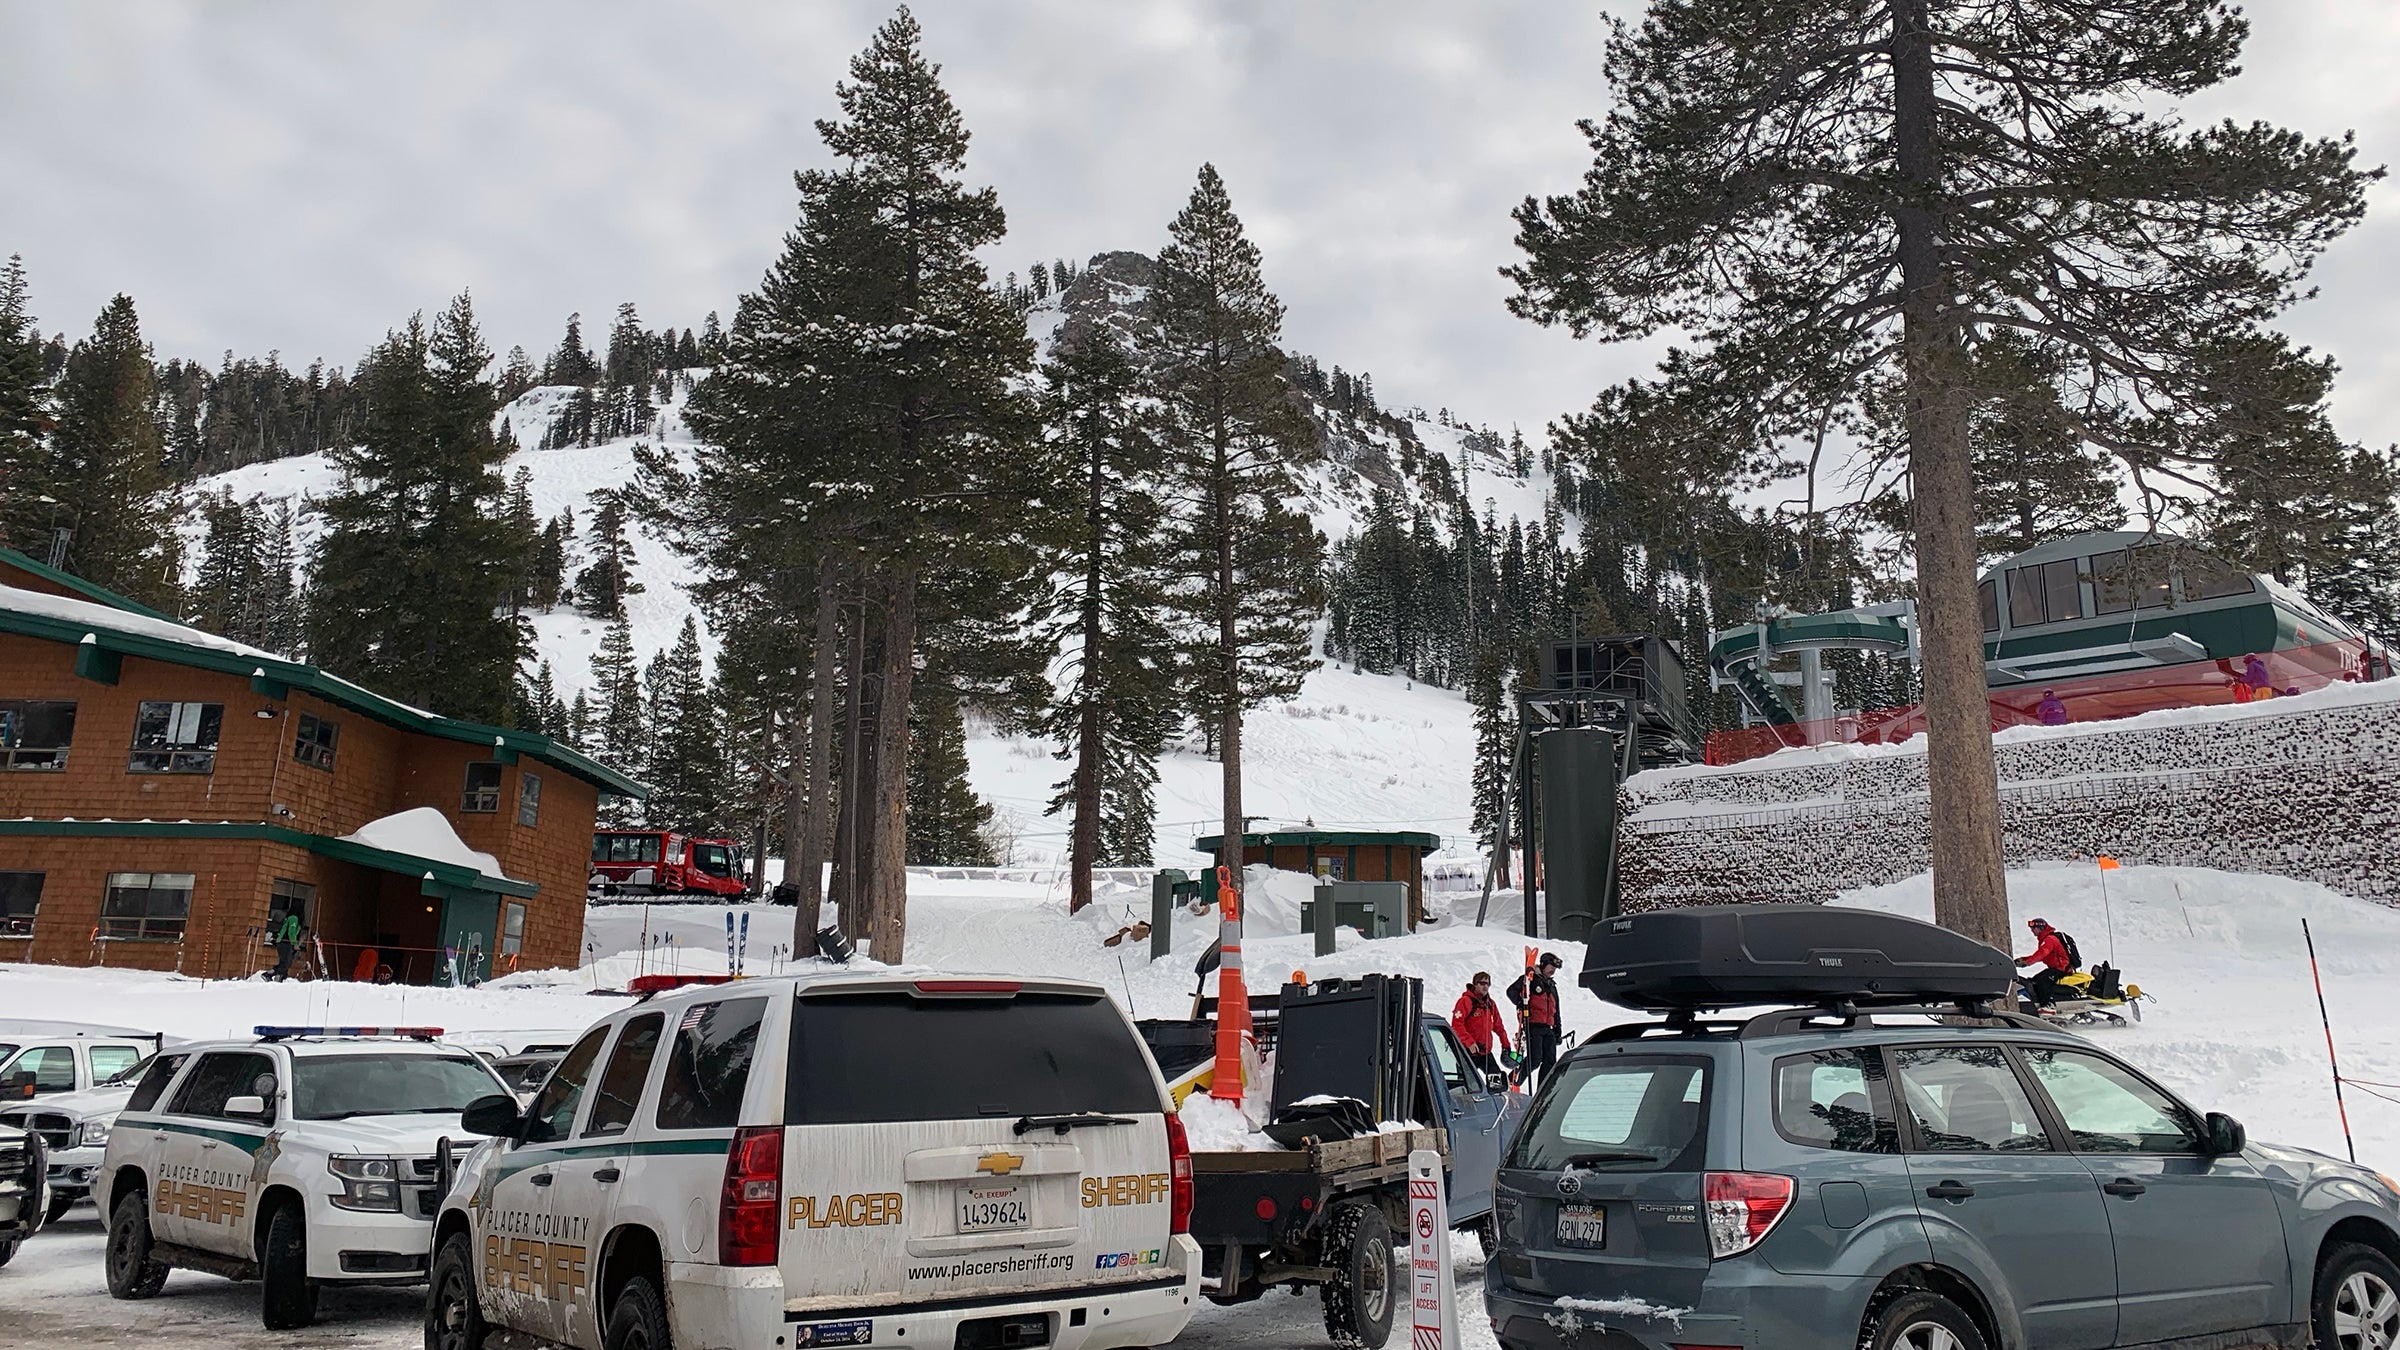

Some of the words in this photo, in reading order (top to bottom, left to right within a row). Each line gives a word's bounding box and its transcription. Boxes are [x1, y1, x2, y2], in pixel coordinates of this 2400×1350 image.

[1612, 920, 1632, 932] THULE
[1819, 957, 1843, 967] THULE
[159, 1163, 199, 1182] PLACER
[203, 1169, 250, 1190] COUNTY
[973, 1192, 984, 1200] CA
[986, 1190, 1013, 1199] EXEMPT
[1081, 1173, 1169, 1208] SHERIFF
[156, 1179, 247, 1227] SHERIFF
[788, 1192, 903, 1230] PLACER
[962, 1201, 1027, 1226] 1439624
[487, 1209, 530, 1234] PLACER
[534, 1213, 589, 1241] COUNTY
[1421, 1243, 1430, 1255] NO
[485, 1234, 587, 1304] SHERIFF
[908, 1253, 1074, 1281] www.placersheriff.org
[1414, 1259, 1438, 1271] PARKING
[1164, 1288, 1179, 1297] 1196
[1420, 1282, 1432, 1294] LIFT
[1416, 1298, 1438, 1311] ACCESS
